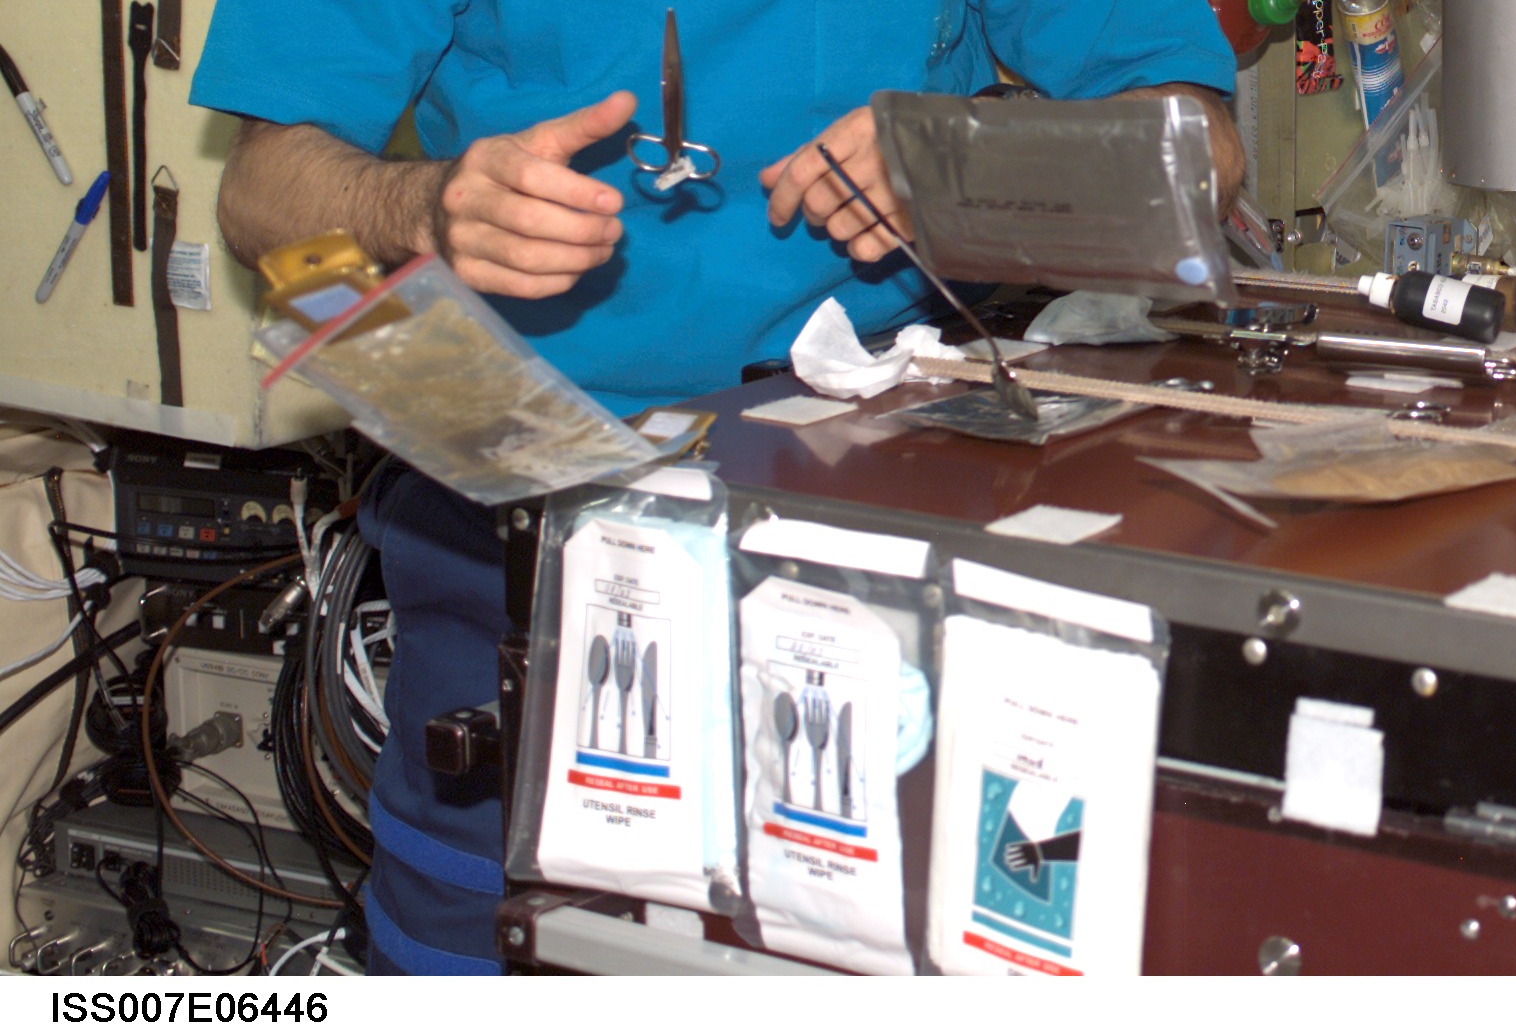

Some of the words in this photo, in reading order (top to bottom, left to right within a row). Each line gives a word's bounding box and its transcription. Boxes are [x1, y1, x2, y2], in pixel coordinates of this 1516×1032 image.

[1431, 284, 1444, 311] TABASCO
[585, 776, 614, 788] RESEAL
[616, 781, 638, 792] AFTER
[642, 786, 658, 794] USE
[583, 798, 623, 814] UTENSIL
[626, 806, 656, 819] RINSE
[606, 815, 631, 827] WIPE
[784, 848, 825, 868] UTENSIL
[827, 860, 856, 876] RINSE
[808, 867, 833, 880] WIPE
